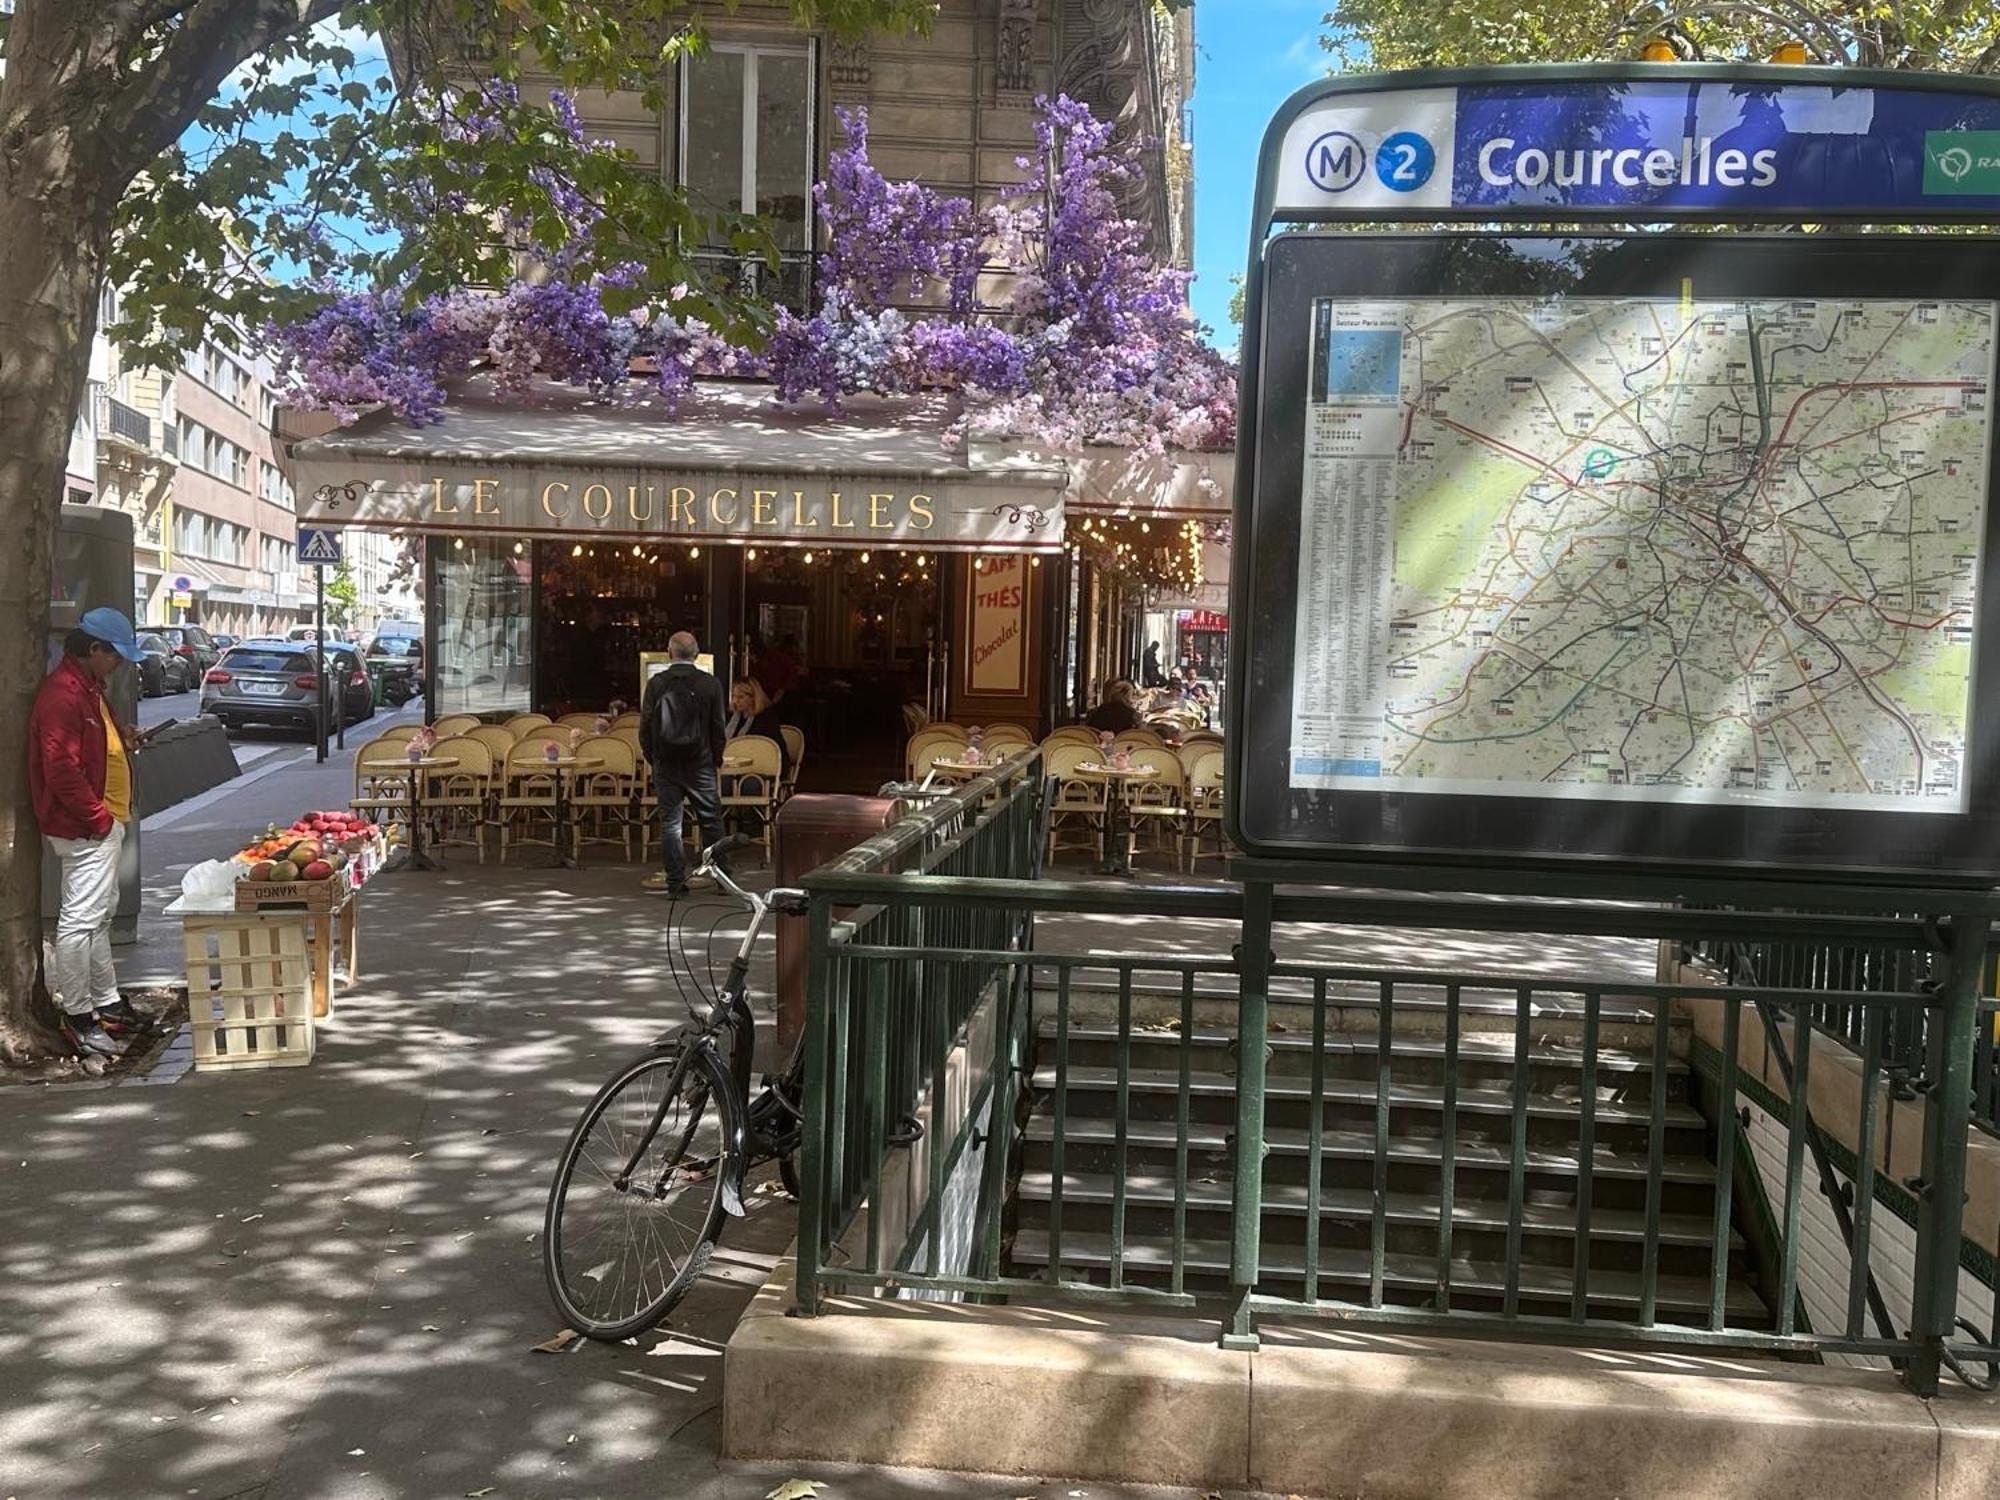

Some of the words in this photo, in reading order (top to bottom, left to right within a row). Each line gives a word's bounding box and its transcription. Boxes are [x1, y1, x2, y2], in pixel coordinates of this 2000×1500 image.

[1478, 136, 1778, 188] Courcelles
[432, 477, 501, 515] LE
[542, 482, 935, 530] COURCELLES
[975, 619, 1018, 665] Chocolat
